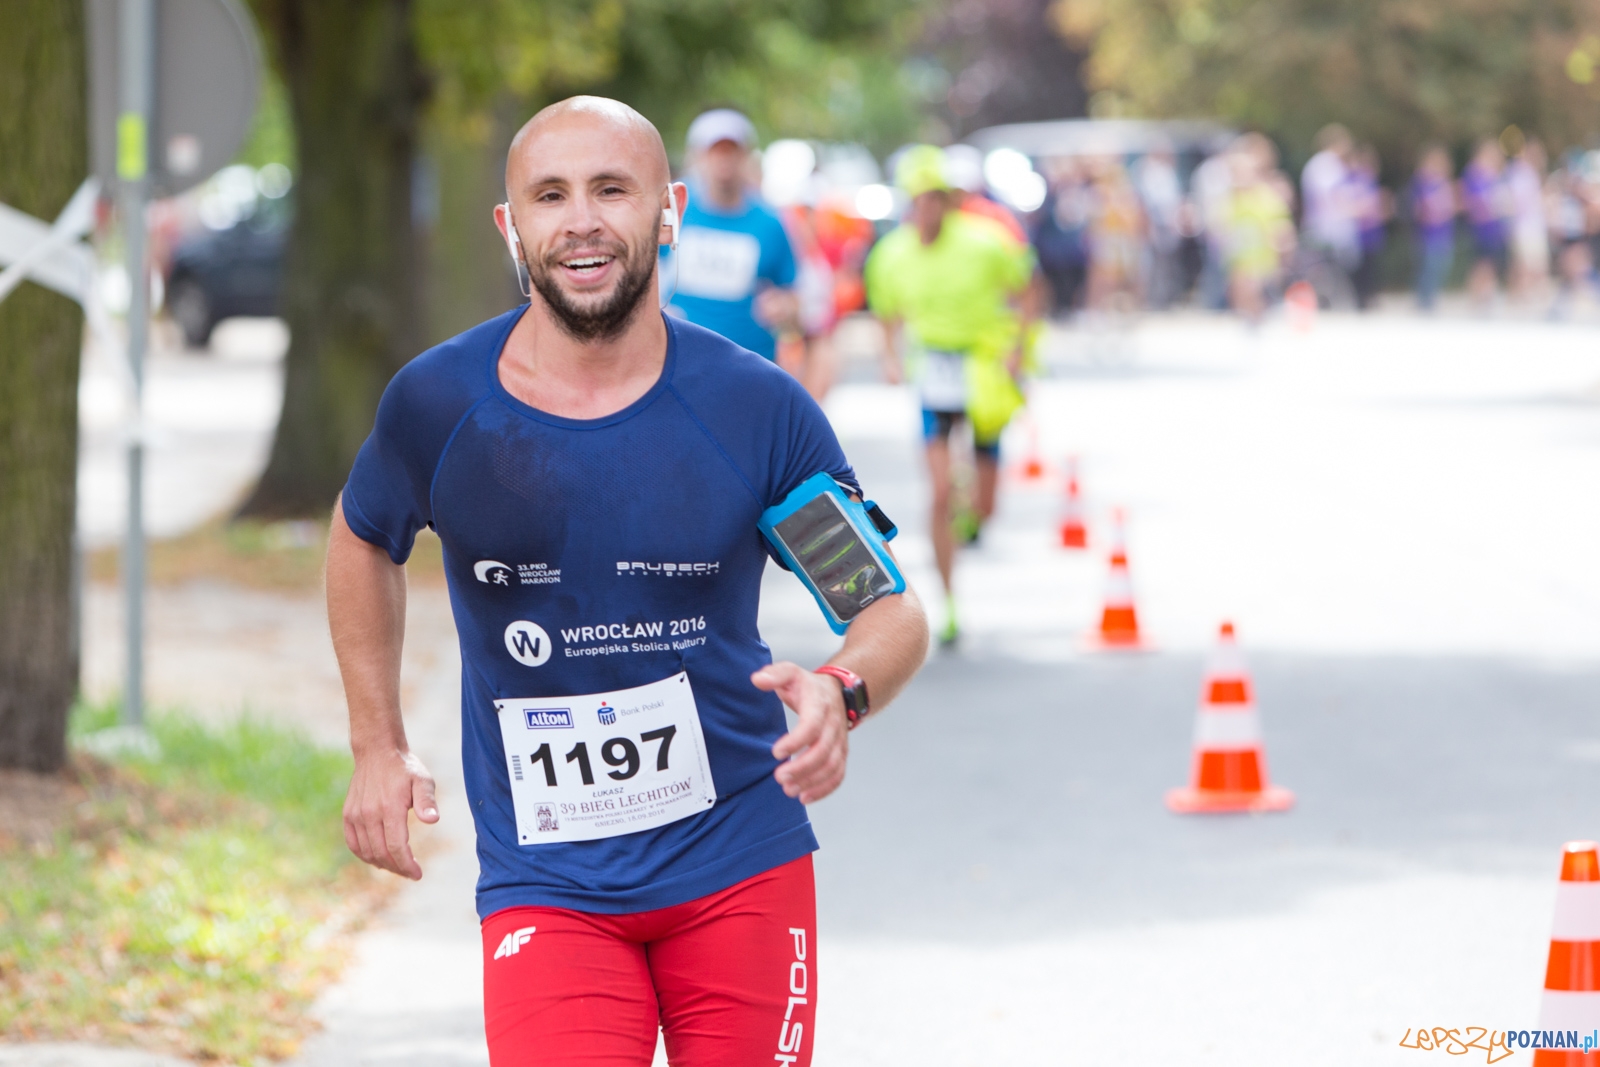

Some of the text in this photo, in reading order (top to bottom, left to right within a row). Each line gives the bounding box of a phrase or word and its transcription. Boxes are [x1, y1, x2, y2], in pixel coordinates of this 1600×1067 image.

[616, 562, 719, 572] BRUBECK
[520, 577, 561, 585] MARATON
[561, 615, 706, 644] WROCŁAW 2016
[564, 635, 707, 657] Europejska Stolica Kultury
[620, 701, 665, 717] Bank Polski
[530, 724, 677, 787] 1197
[560, 803, 577, 816] 39
[580, 799, 615, 814] BIEG
[619, 776, 692, 808] LECHITÓW
[592, 787, 624, 798] ŁUKASZ
